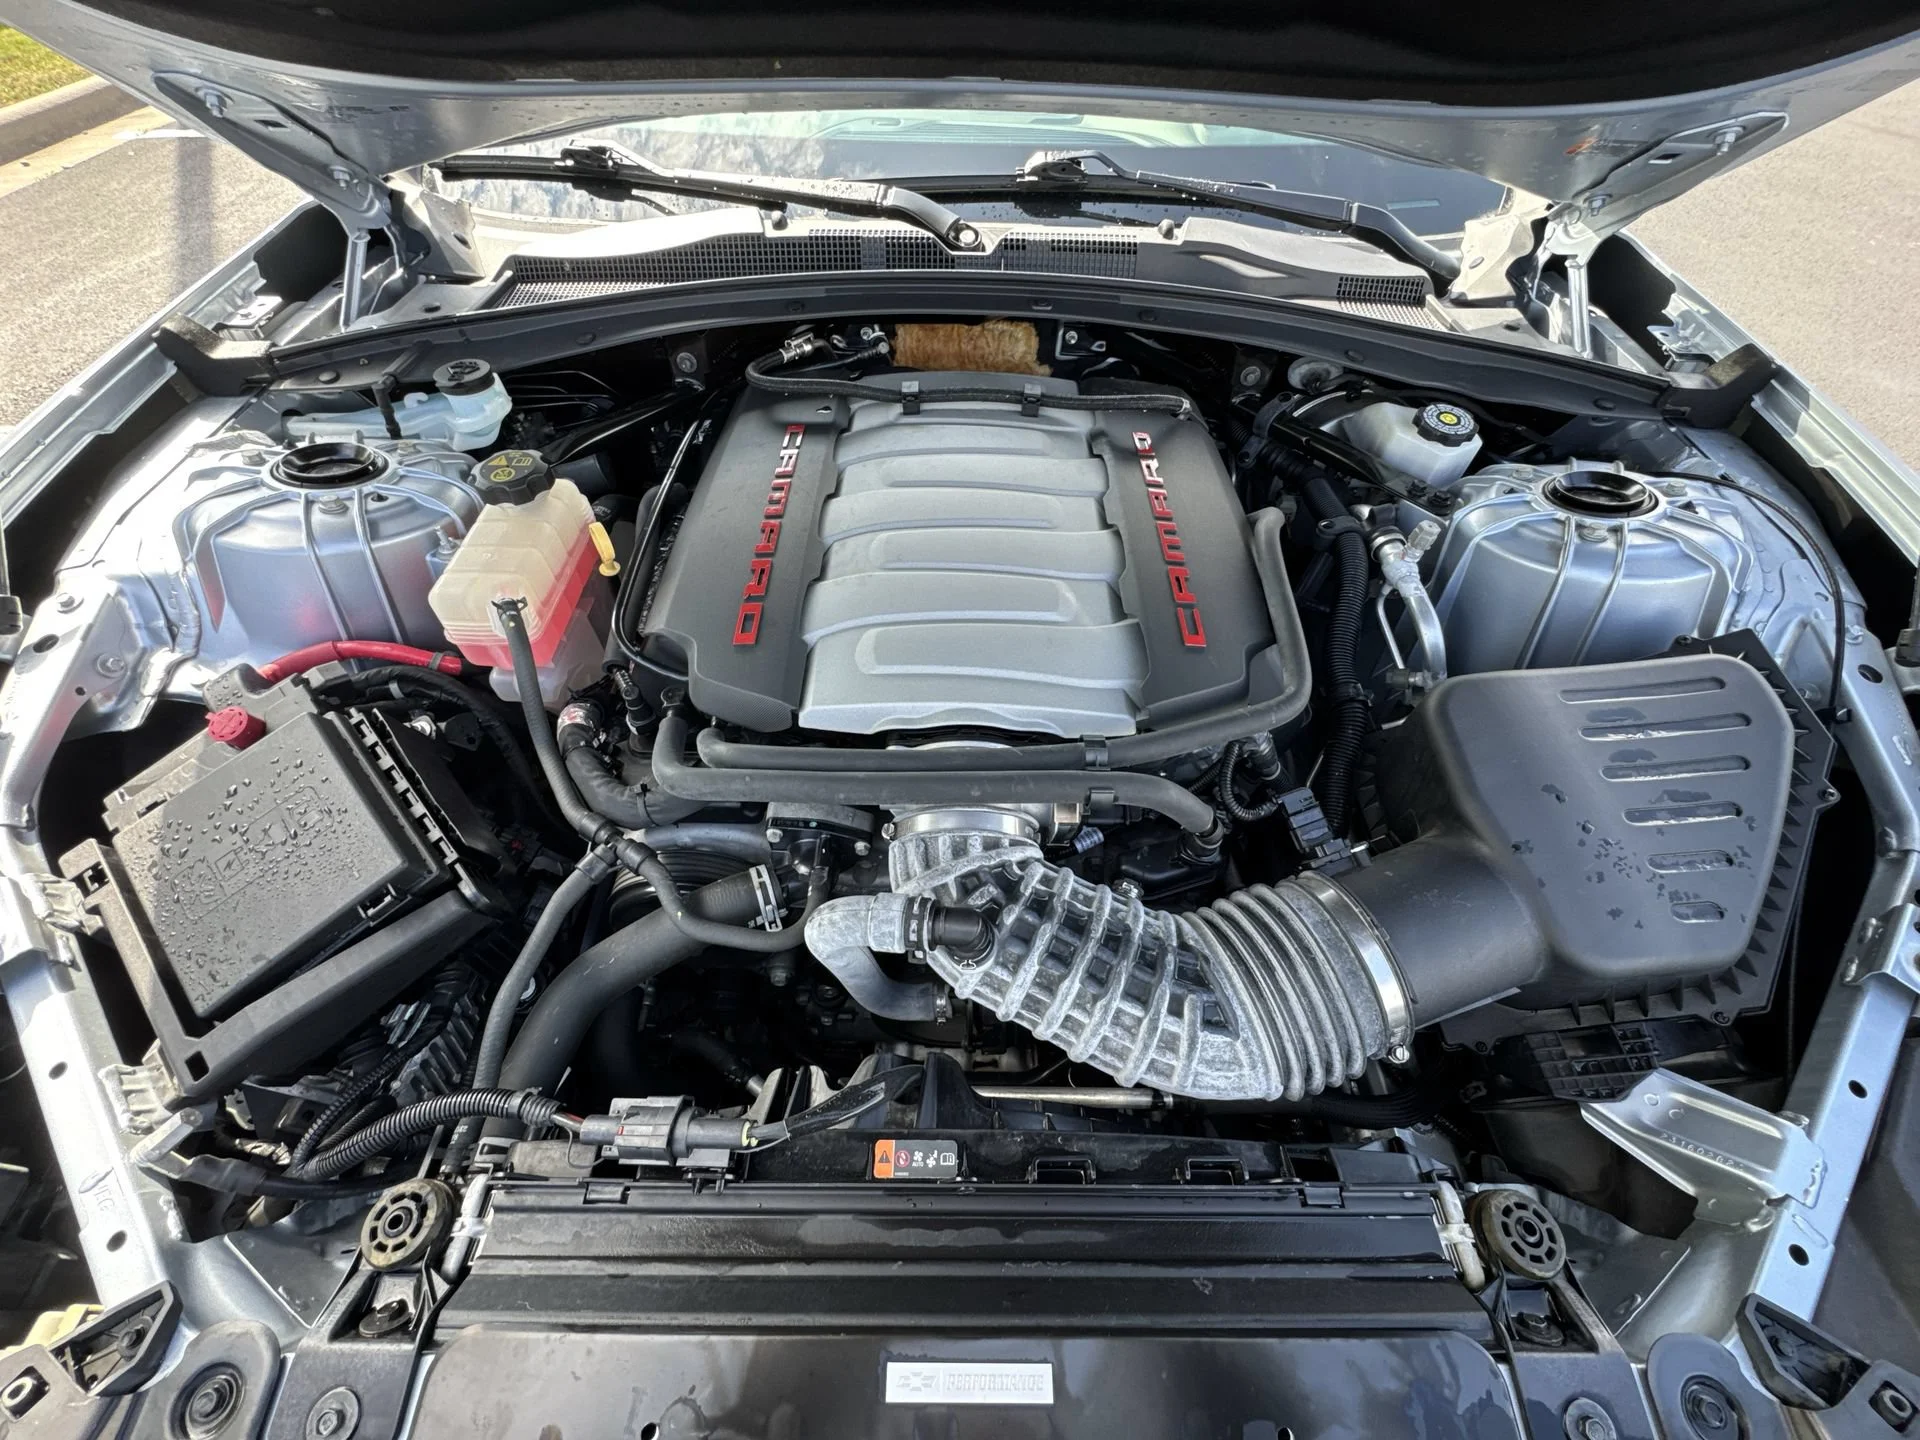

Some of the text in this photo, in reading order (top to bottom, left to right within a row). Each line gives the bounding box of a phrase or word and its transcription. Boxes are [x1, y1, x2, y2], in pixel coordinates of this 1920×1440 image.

[733, 424, 805, 645] CAMARO
[1133, 431, 1207, 647] CAMARO
[946, 1374, 1044, 1391] PERFORMANCE
